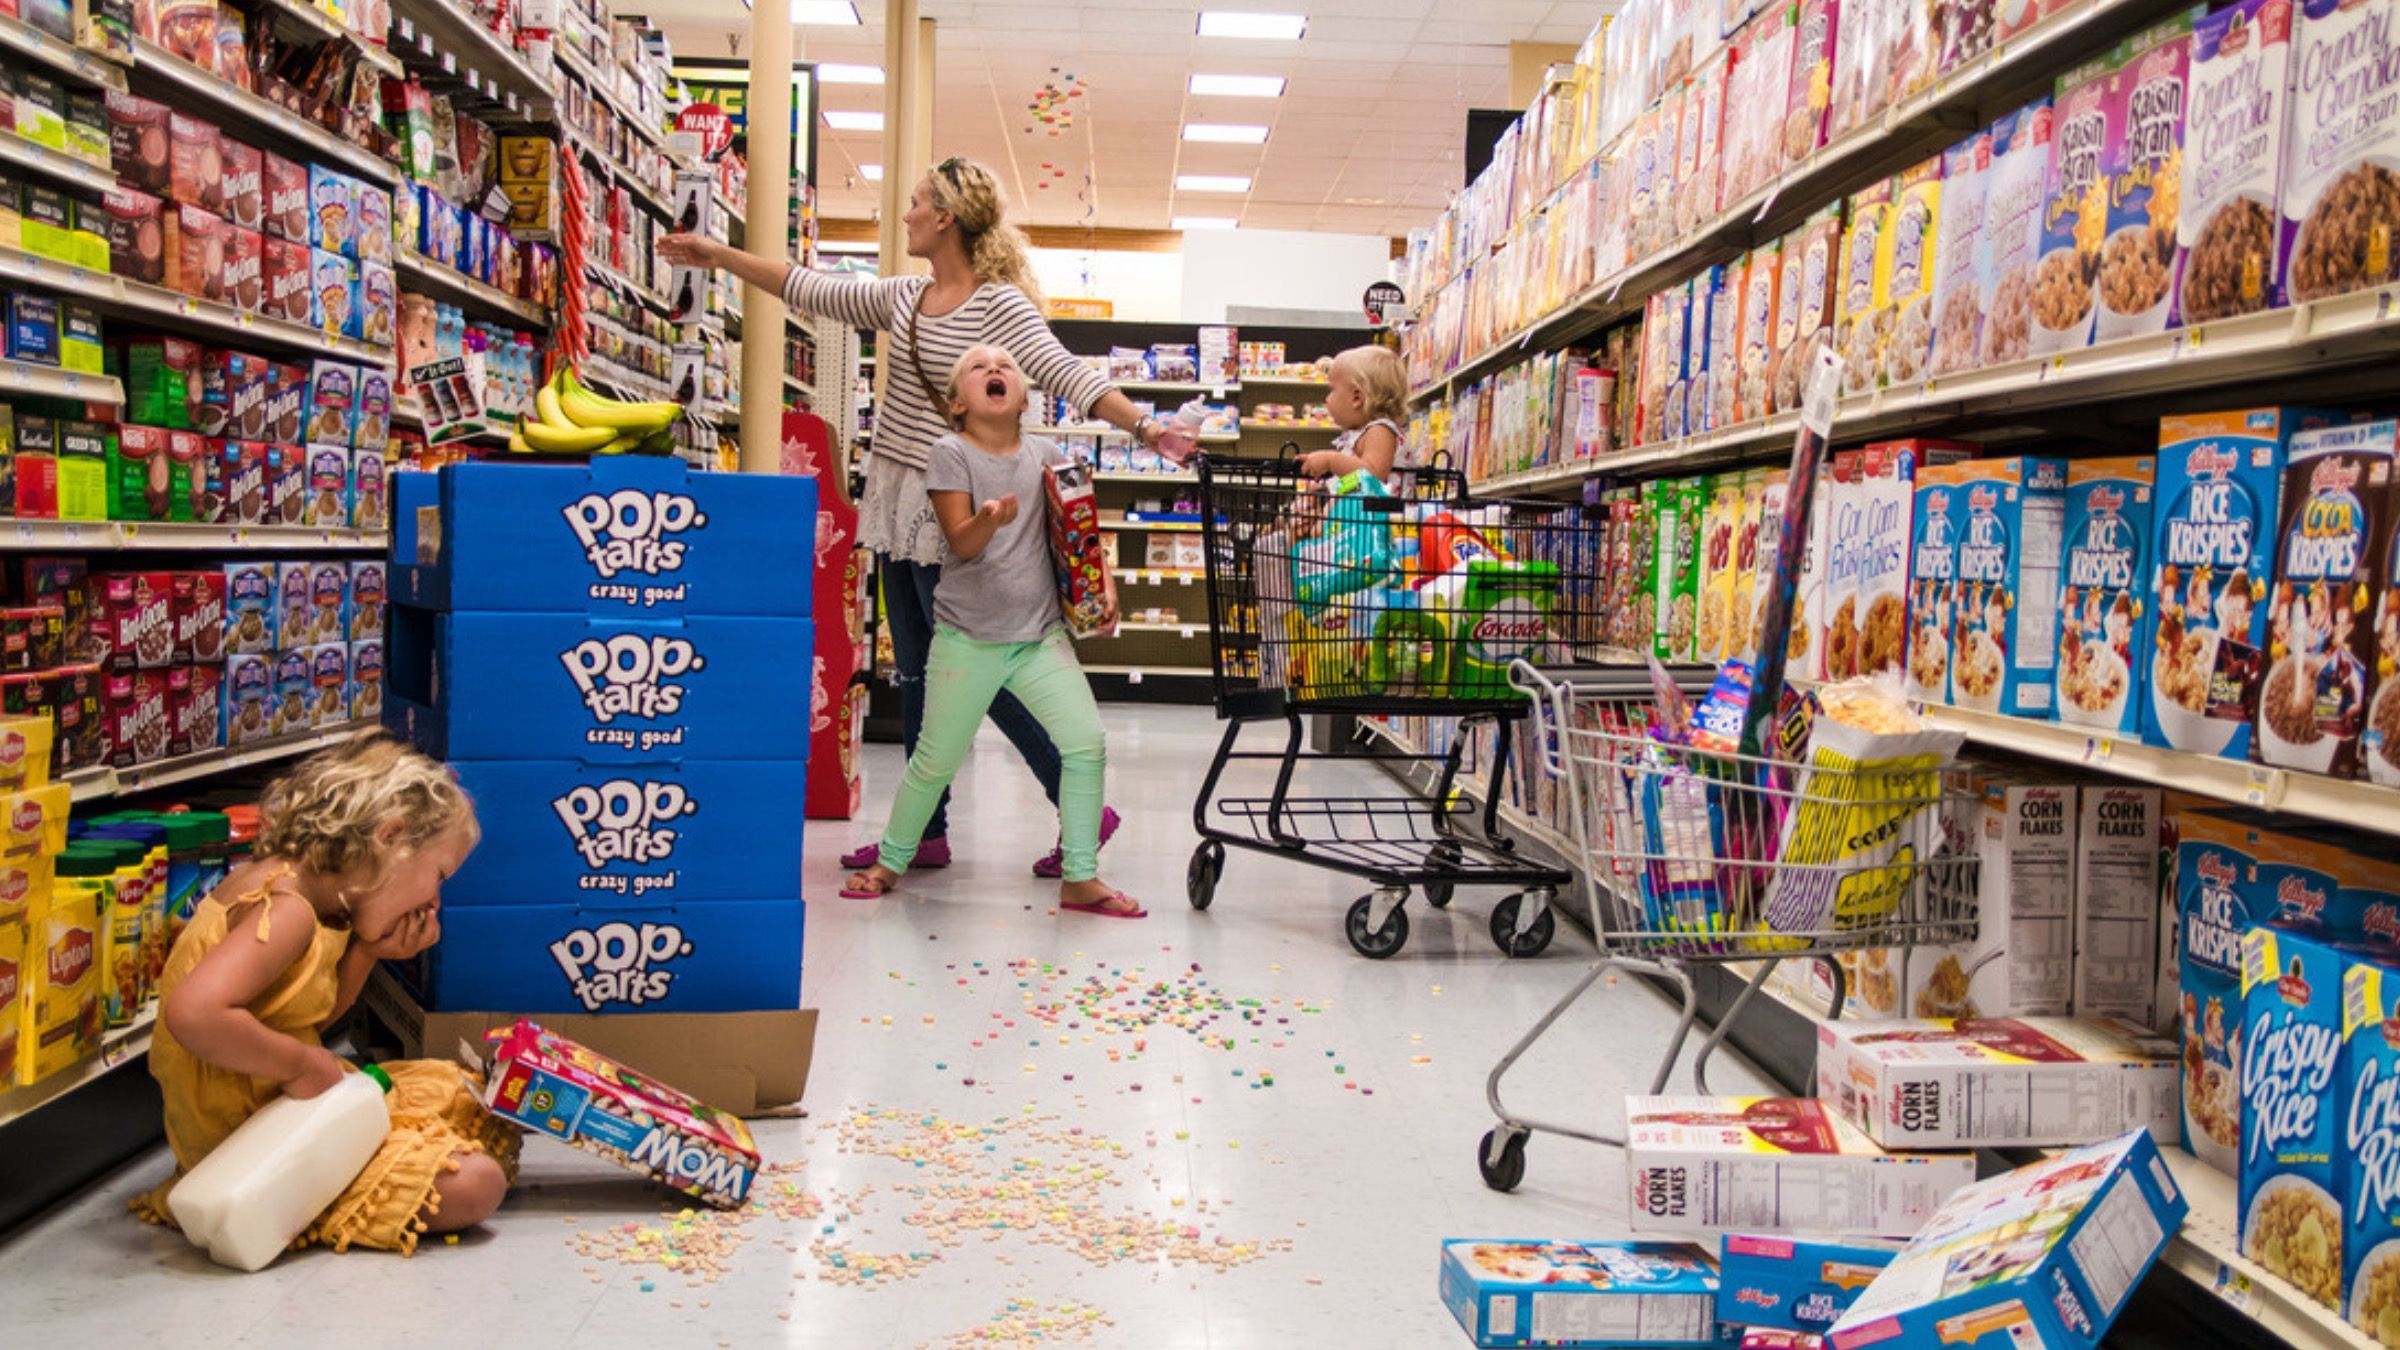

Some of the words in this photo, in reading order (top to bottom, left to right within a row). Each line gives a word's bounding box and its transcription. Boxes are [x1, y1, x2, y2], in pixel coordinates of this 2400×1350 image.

[683, 114, 727, 129] WANT
[2130, 80, 2181, 133] Raisin
[2354, 92, 2398, 135] Bran
[2061, 113, 2104, 158] Raisin
[2130, 121, 2173, 168] Bran
[2062, 151, 2096, 190] Bran
[1370, 288, 1400, 301] NEED
[1868, 498, 1899, 540] Corn
[2190, 484, 2230, 522] RICE
[2303, 497, 2352, 538] COCOA
[1971, 516, 1993, 546] RICE
[2088, 518, 2117, 550] RICE
[2168, 520, 2249, 565] KRISPIES
[2071, 547, 2133, 588] KRISPIES
[2286, 532, 2359, 577] KRISPIES
[589, 585, 637, 605] crazy
[644, 583, 685, 607] good
[1472, 616, 1545, 641] Cascade
[587, 729, 634, 748] crazy
[641, 727, 682, 750] good
[2019, 801, 2063, 819] CORN
[2019, 820, 2063, 836] FLAKES
[2097, 802, 2146, 820] CORN
[2098, 821, 2145, 837] FLAKES
[580, 874, 627, 894] crazy
[634, 872, 675, 896] good
[2202, 886, 2233, 929] RICE
[51, 942, 92, 979] Lipton
[2188, 914, 2243, 968] KRISPIE
[2244, 1011, 2341, 1098] Crispy
[1903, 1081, 1922, 1132] CORN
[1924, 1079, 1941, 1131] FLAKES
[2248, 1075, 2317, 1164] Rice
[630, 1127, 745, 1200] MOM
[1649, 1166, 1668, 1217] CORN
[1670, 1166, 1687, 1216] FLAKES
[1809, 1293, 1833, 1306] RICE
